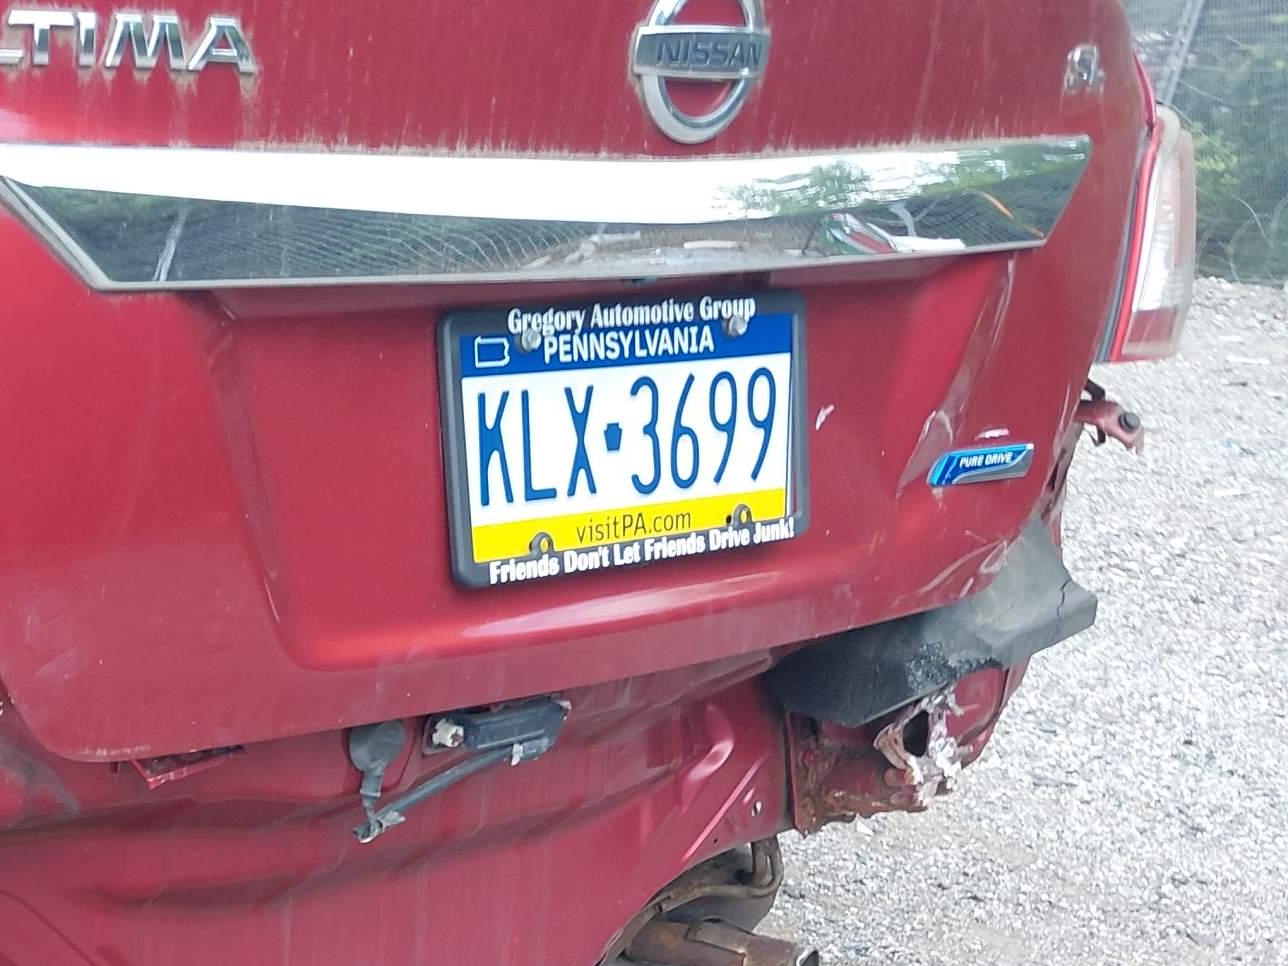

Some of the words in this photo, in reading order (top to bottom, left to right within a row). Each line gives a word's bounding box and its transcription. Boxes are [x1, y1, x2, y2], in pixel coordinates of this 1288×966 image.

[655, 36, 762, 67] NISSAN
[508, 307, 586, 337] Gregory
[590, 299, 694, 329] Automotive
[699, 296, 756, 320] Group
[544, 326, 714, 364] PENNSYLVANIA
[959, 454, 983, 468] PURE
[985, 451, 1013, 465] DRIVE
[576, 511, 692, 544] visitPA.com
[489, 552, 560, 585] Friends
[564, 546, 610, 573] Don't
[613, 540, 642, 566] Let
[644, 532, 706, 561] Friends
[709, 526, 750, 551] Drive
[753, 517, 795, 544] Junk!
